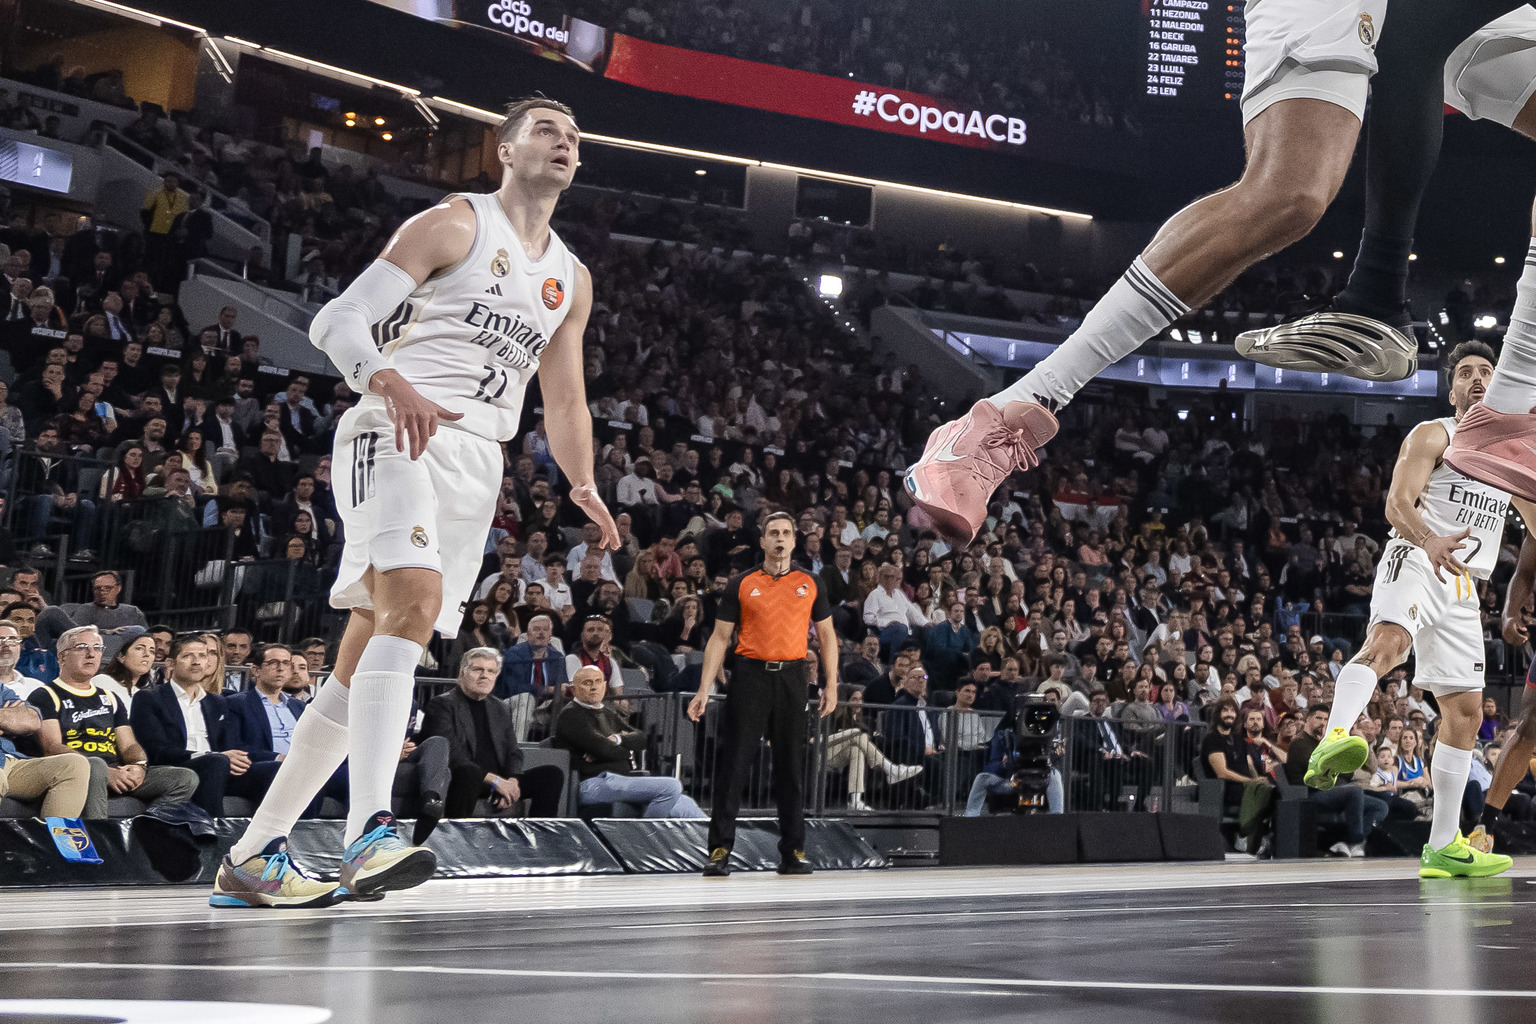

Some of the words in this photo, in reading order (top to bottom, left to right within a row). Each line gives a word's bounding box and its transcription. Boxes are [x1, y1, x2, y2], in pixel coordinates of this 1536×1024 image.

[1150, 8, 1161, 17] 11
[1162, 9, 1201, 20] HEZONJA
[487, 3, 545, 38] Copa
[545, 26, 569, 44] del
[1149, 19, 1160, 28] 12
[1161, 20, 1204, 32] MALEDON
[1149, 30, 1160, 39] 14
[1161, 31, 1184, 41] DECK
[1148, 41, 1160, 50] 16
[1161, 42, 1197, 53] GARUBA
[1147, 52, 1159, 61] 22
[1160, 53, 1199, 65] TAVARES
[1147, 63, 1159, 72] 23
[1160, 64, 1185, 75] LLULL
[1147, 75, 1159, 83] 24
[1160, 76, 1184, 86] FELIZ
[1146, 86, 1158, 95] 25
[1159, 87, 1177, 96] LEN
[852, 90, 1027, 145] #CopaACB
[464, 301, 548, 357] Emirate
[1449, 483, 1507, 518] Emirate
[1456, 507, 1475, 525] FLY
[1474, 512, 1499, 533] BETT
[62, 699, 75, 709] 12
